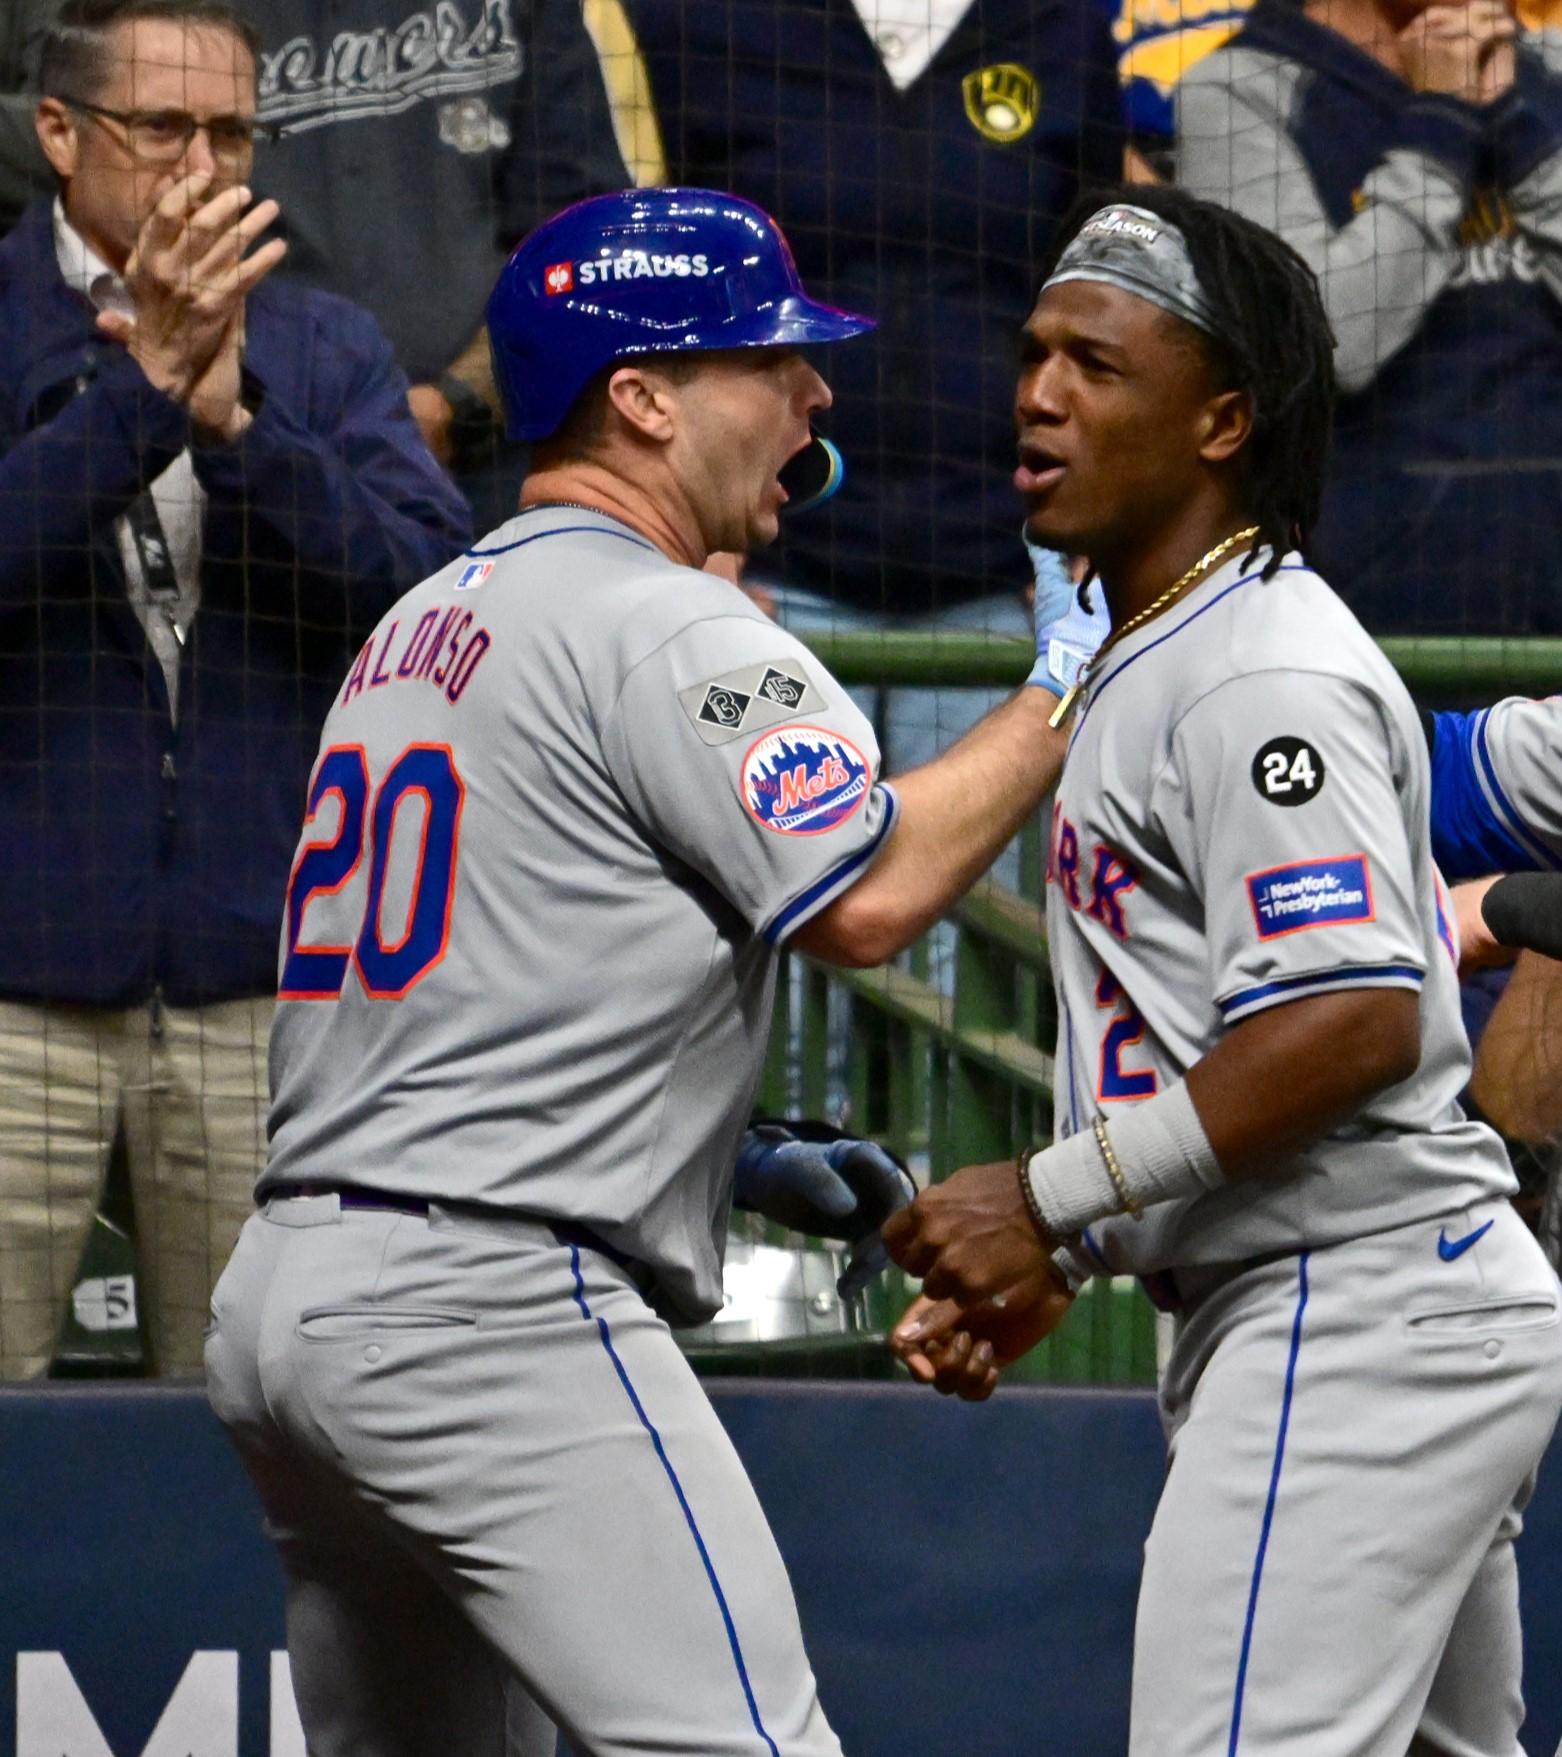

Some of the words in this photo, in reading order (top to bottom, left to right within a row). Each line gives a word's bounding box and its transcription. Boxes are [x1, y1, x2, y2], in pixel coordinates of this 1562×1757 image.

[579, 253, 709, 285] STRAUSS
[340, 604, 493, 706] ALONSO
[771, 755, 850, 817] Mets
[1262, 747, 1317, 794] 24
[276, 740, 467, 1002] 20
[1046, 800, 1141, 942] RK
[1270, 872, 1342, 901] NewYork-
[1272, 888, 1364, 918] Presbyterian
